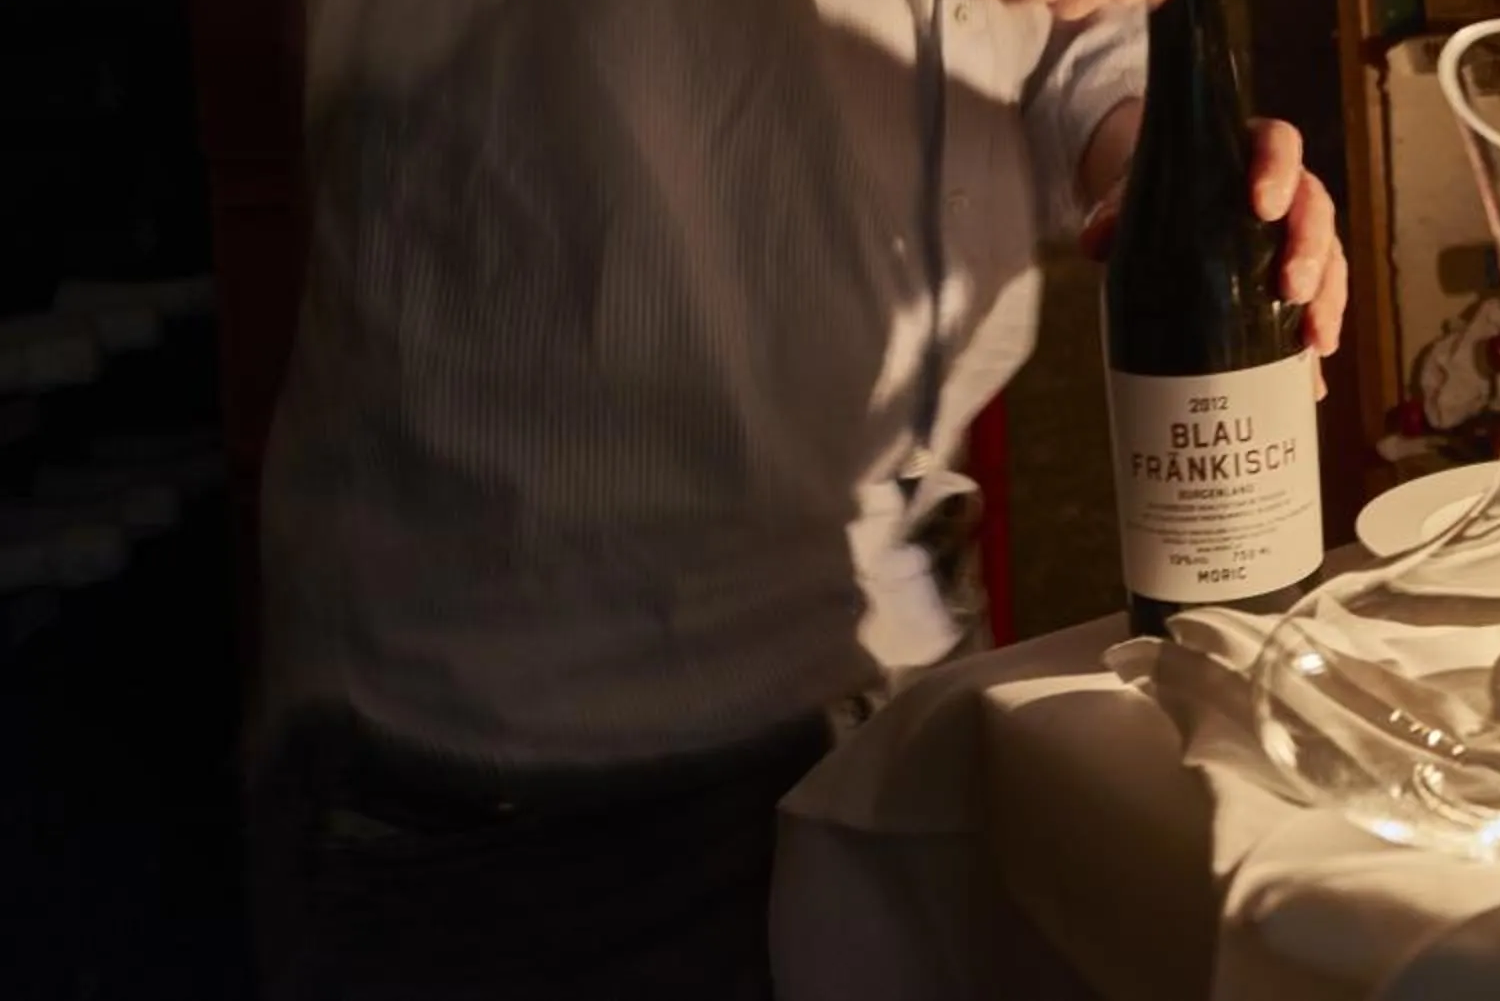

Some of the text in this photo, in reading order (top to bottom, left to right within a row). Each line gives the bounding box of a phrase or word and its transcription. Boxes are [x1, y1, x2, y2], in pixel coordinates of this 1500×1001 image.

[1189, 396, 1228, 413] 2012
[1171, 416, 1253, 449] BLAU
[1131, 439, 1297, 481] FRÄNKISCH
[1198, 566, 1247, 583] MORIC
